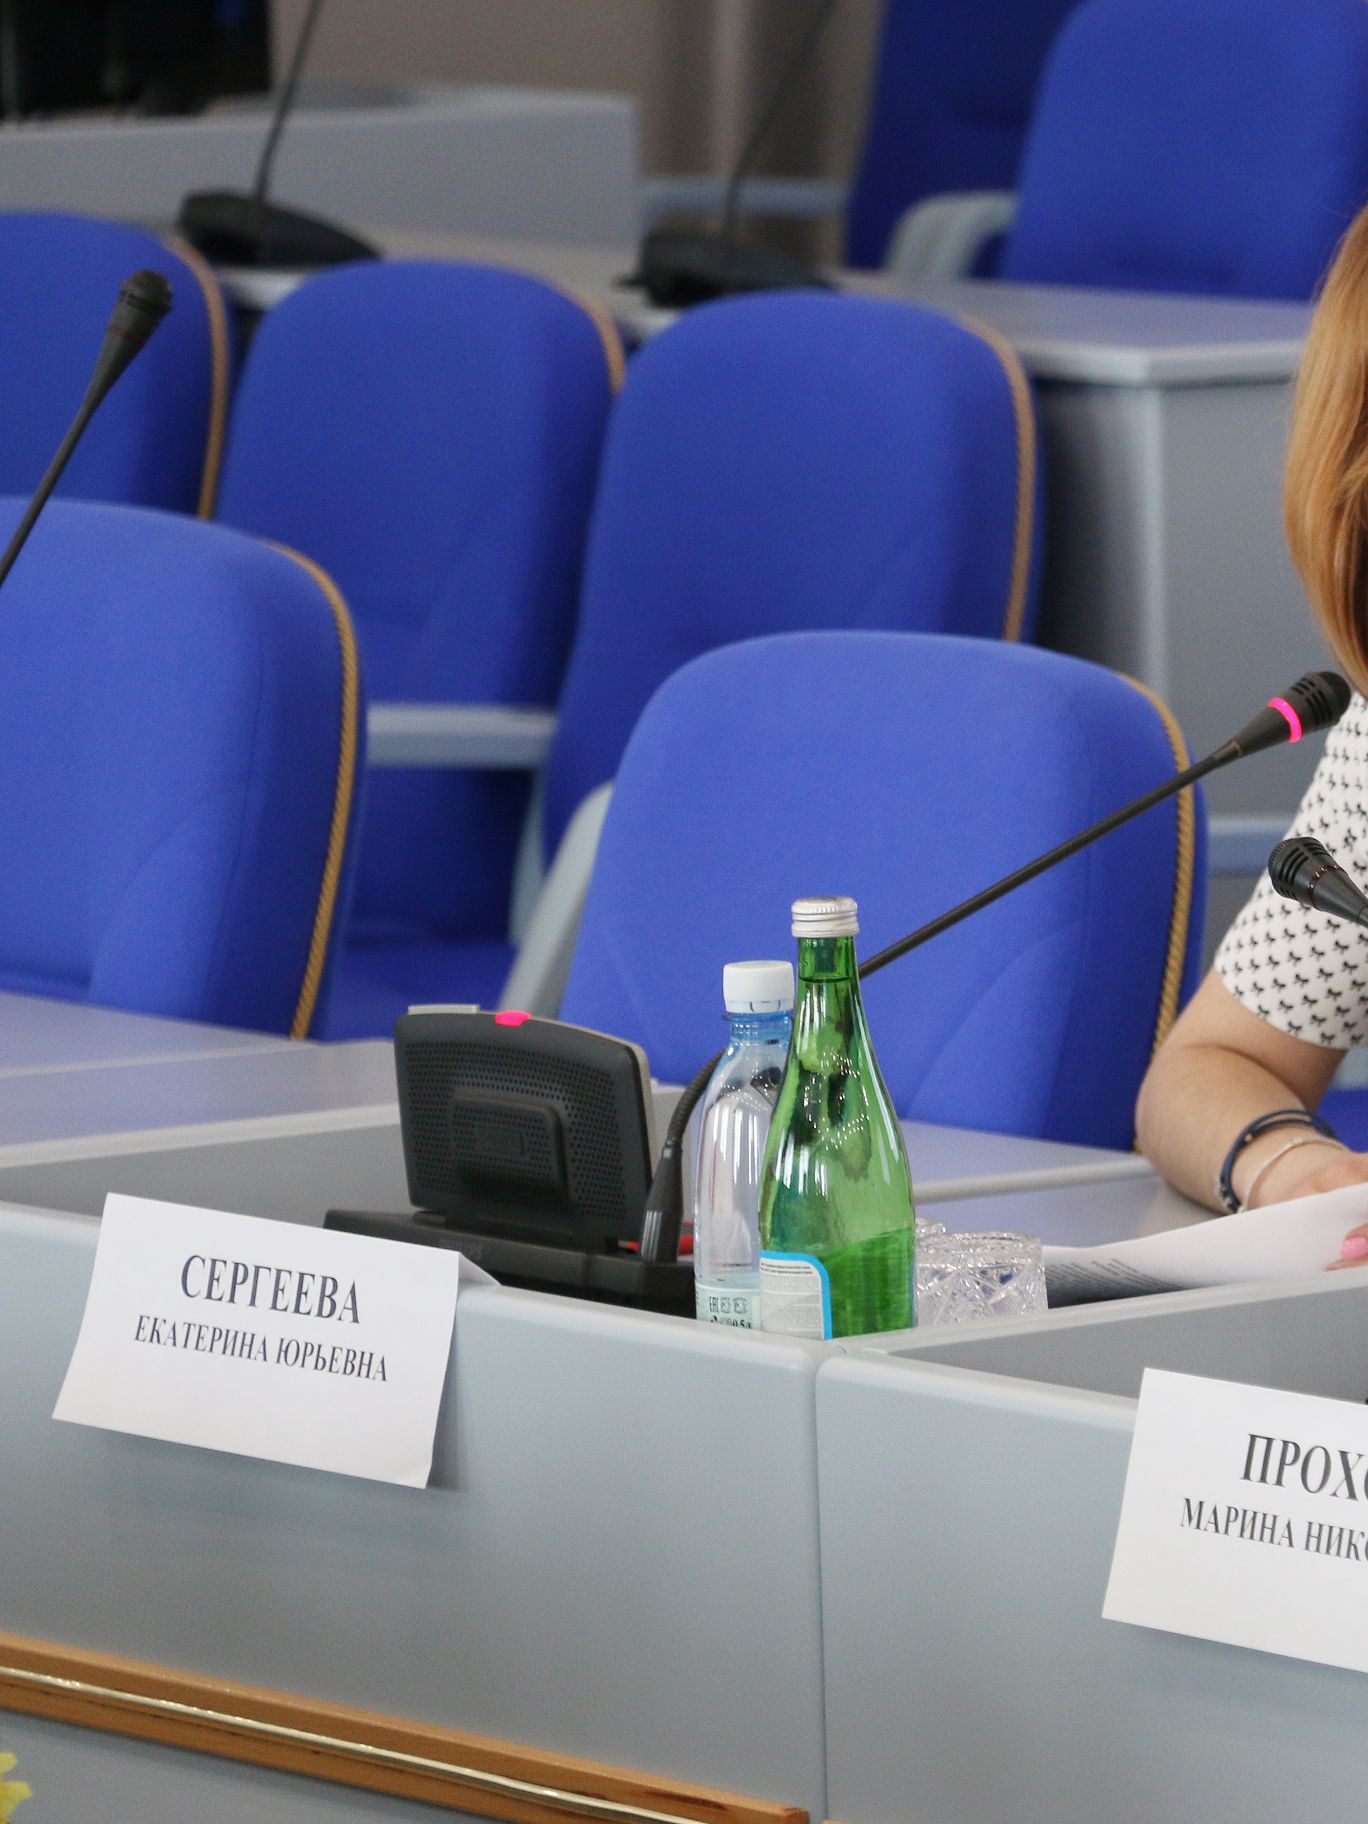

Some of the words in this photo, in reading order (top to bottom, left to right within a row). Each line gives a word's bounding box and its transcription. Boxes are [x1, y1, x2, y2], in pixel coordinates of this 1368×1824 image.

[181, 1254, 360, 1325] СЕРГЕЕВА
[134, 1314, 268, 1363] ЕКАТЕРИНА
[275, 1337, 388, 1382] ЮРЬЕВНА
[1180, 1497, 1295, 1549] МАРИНА
